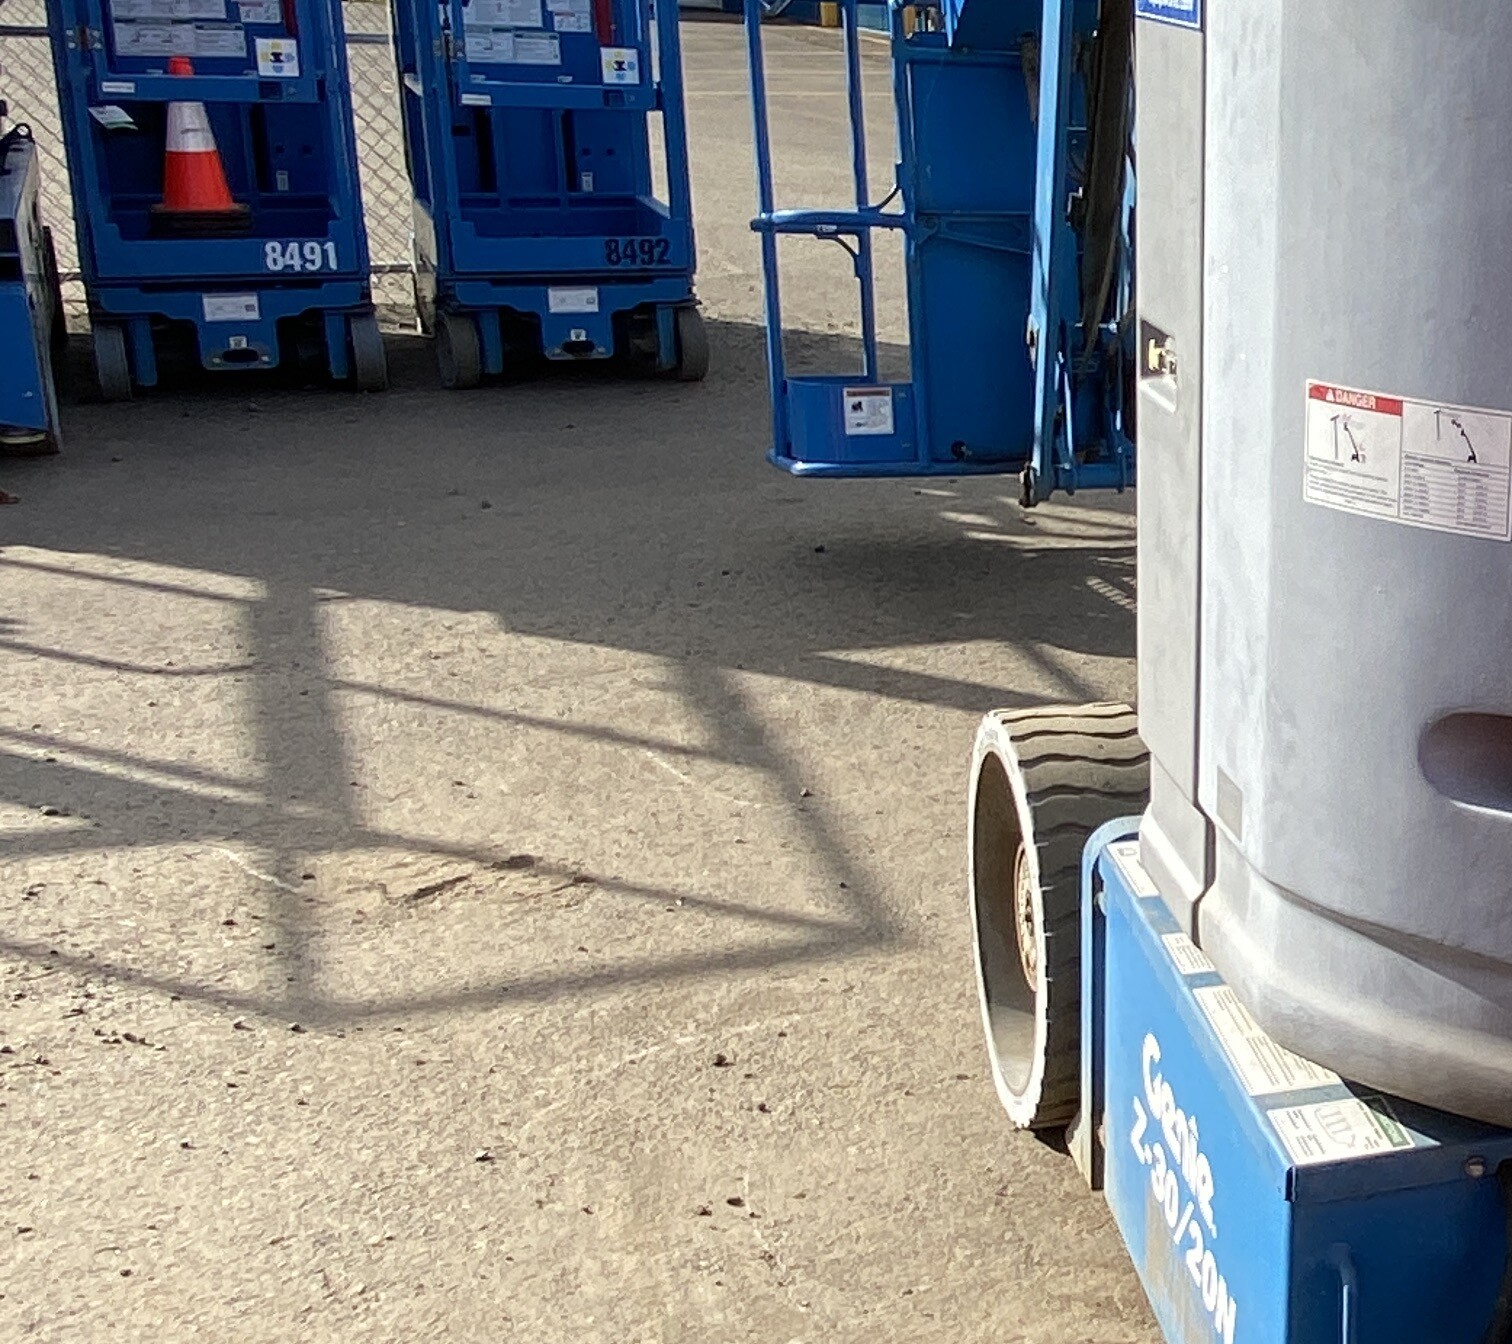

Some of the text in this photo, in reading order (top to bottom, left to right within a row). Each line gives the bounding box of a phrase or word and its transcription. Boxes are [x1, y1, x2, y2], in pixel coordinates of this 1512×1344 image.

[264, 241, 338, 272] 8491
[603, 237, 672, 267] 8492
[1335, 387, 1377, 410] DANGER
[1142, 1032, 1218, 1239] Genie
